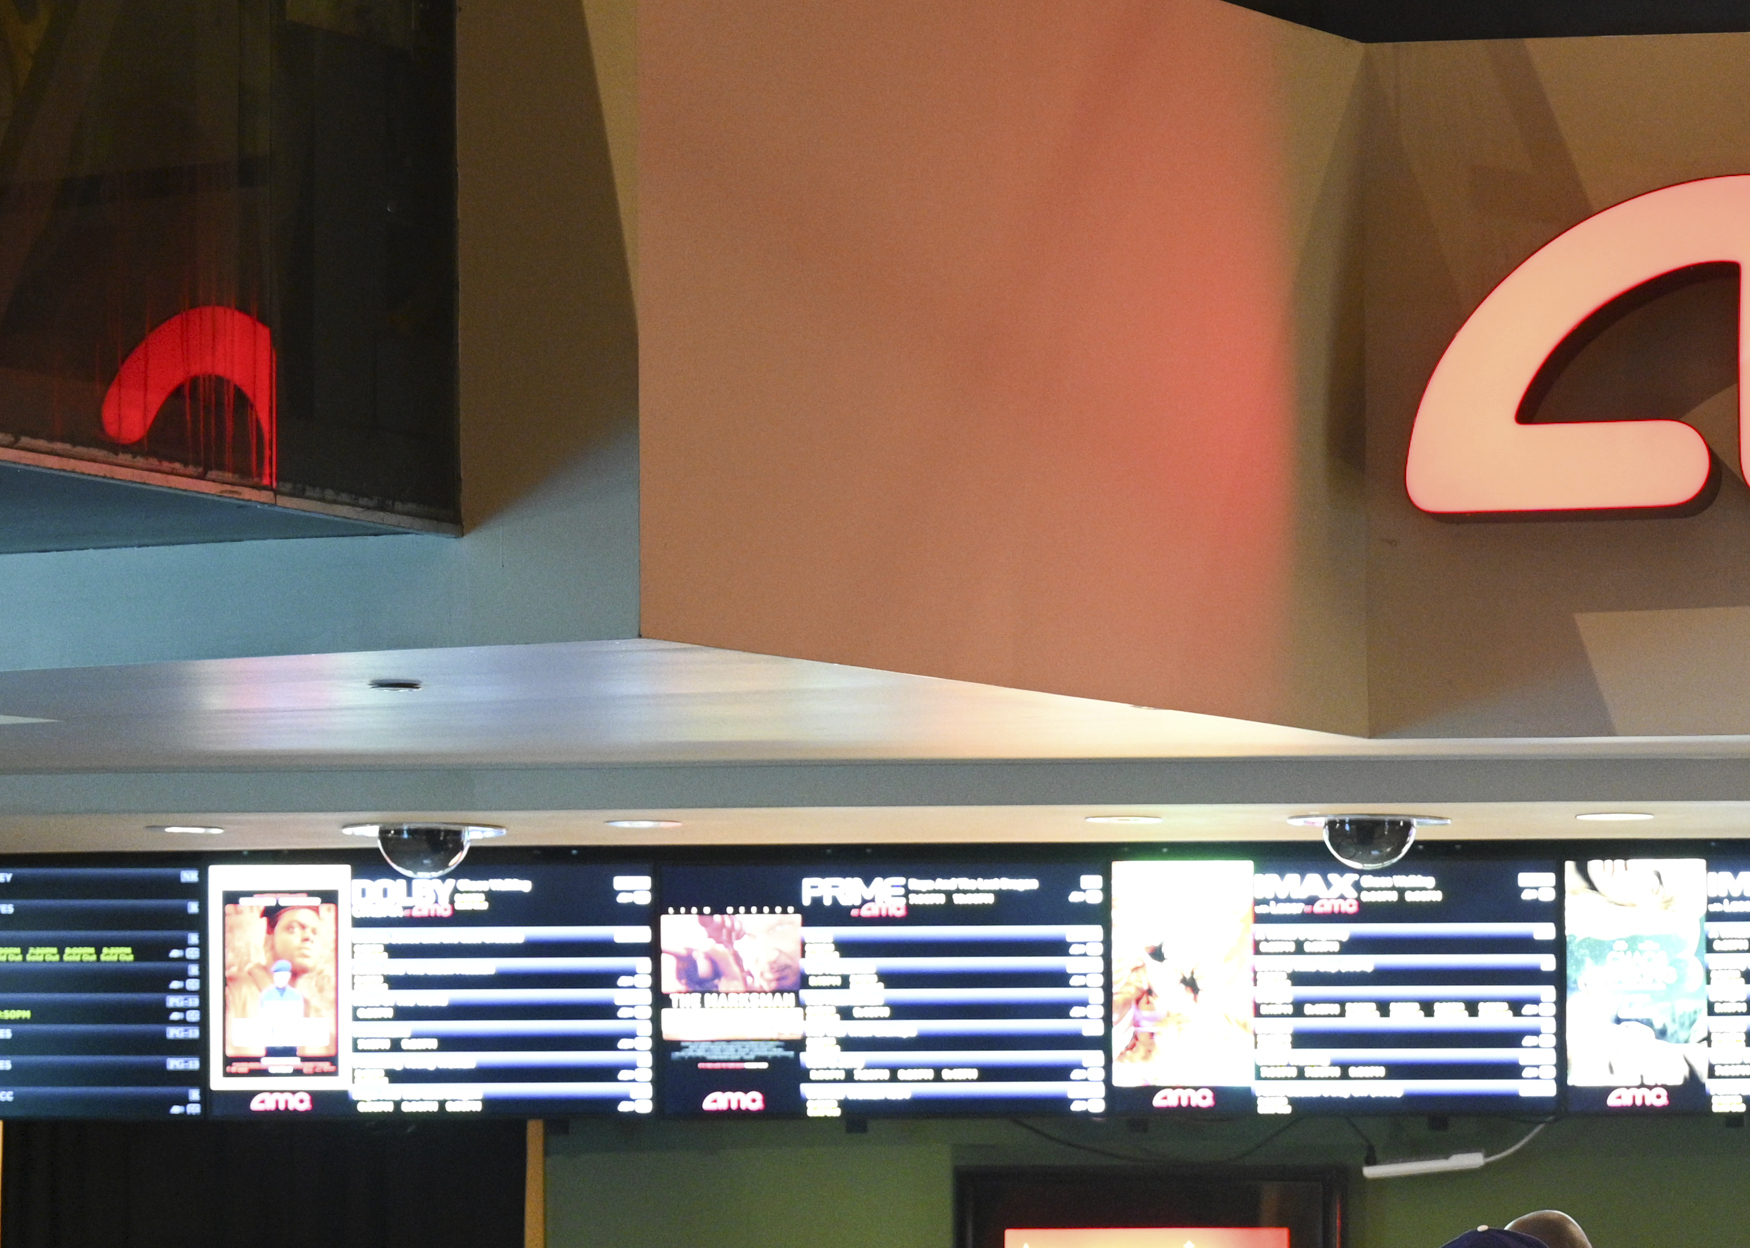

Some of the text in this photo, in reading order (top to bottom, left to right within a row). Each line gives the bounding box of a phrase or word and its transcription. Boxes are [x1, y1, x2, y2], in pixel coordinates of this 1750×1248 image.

[351, 879, 455, 904] DOLBY
[801, 877, 907, 906] PRIME
[1254, 874, 1360, 899] IMAX
[411, 904, 454, 917] amc
[860, 902, 907, 917] amc
[1313, 898, 1359, 914] amc
[250, 1092, 312, 1111] amc
[702, 1091, 764, 1111] amc
[1152, 1088, 1215, 1107] amc
[1607, 1087, 1669, 1107] amc
